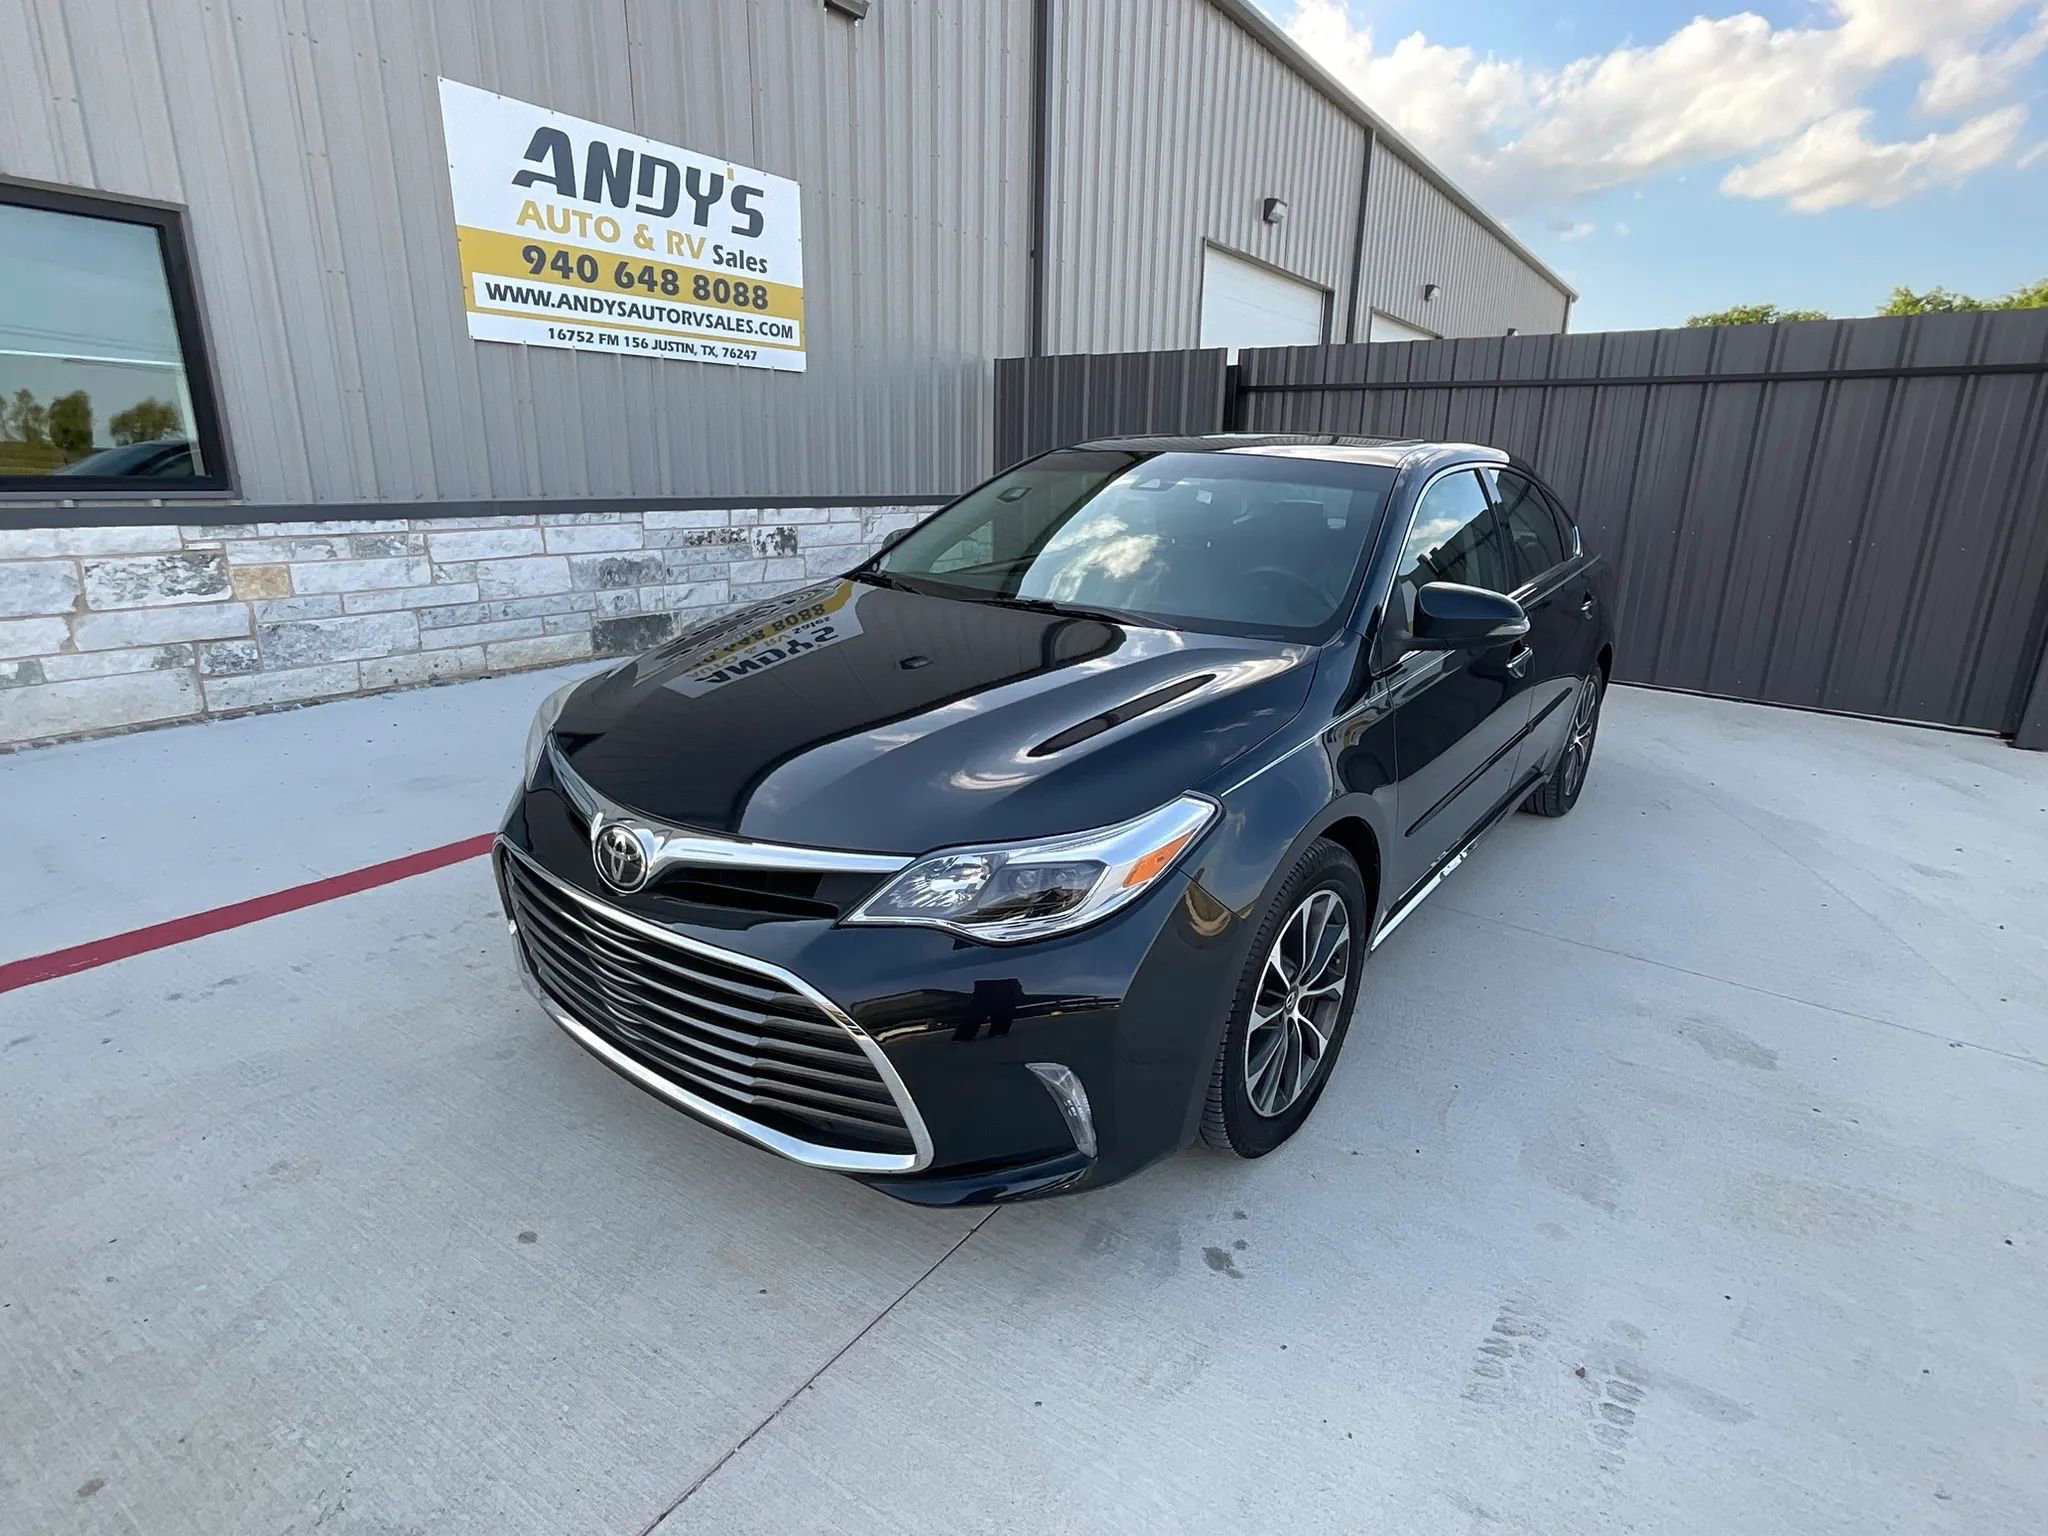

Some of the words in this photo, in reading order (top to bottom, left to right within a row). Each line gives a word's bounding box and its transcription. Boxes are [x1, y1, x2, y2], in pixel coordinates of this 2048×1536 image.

[511, 126, 765, 238] ANDY'S
[515, 200, 621, 243] AUTO
[633, 224, 656, 251] &
[667, 230, 707, 259] RV
[713, 244, 769, 274] Sales
[522, 245, 599, 283] 940
[614, 261, 680, 296] 648
[693, 275, 769, 310] 8088
[485, 282, 794, 340] WWW.ANDYSAUTORVSALES.COM
[548, 327, 594, 344] 16752
[599, 333, 620, 347] FM
[624, 336, 649, 349] 156
[652, 339, 698, 355] JUSTIN,
[700, 344, 719, 358] TX,
[722, 348, 758, 361] 76247
